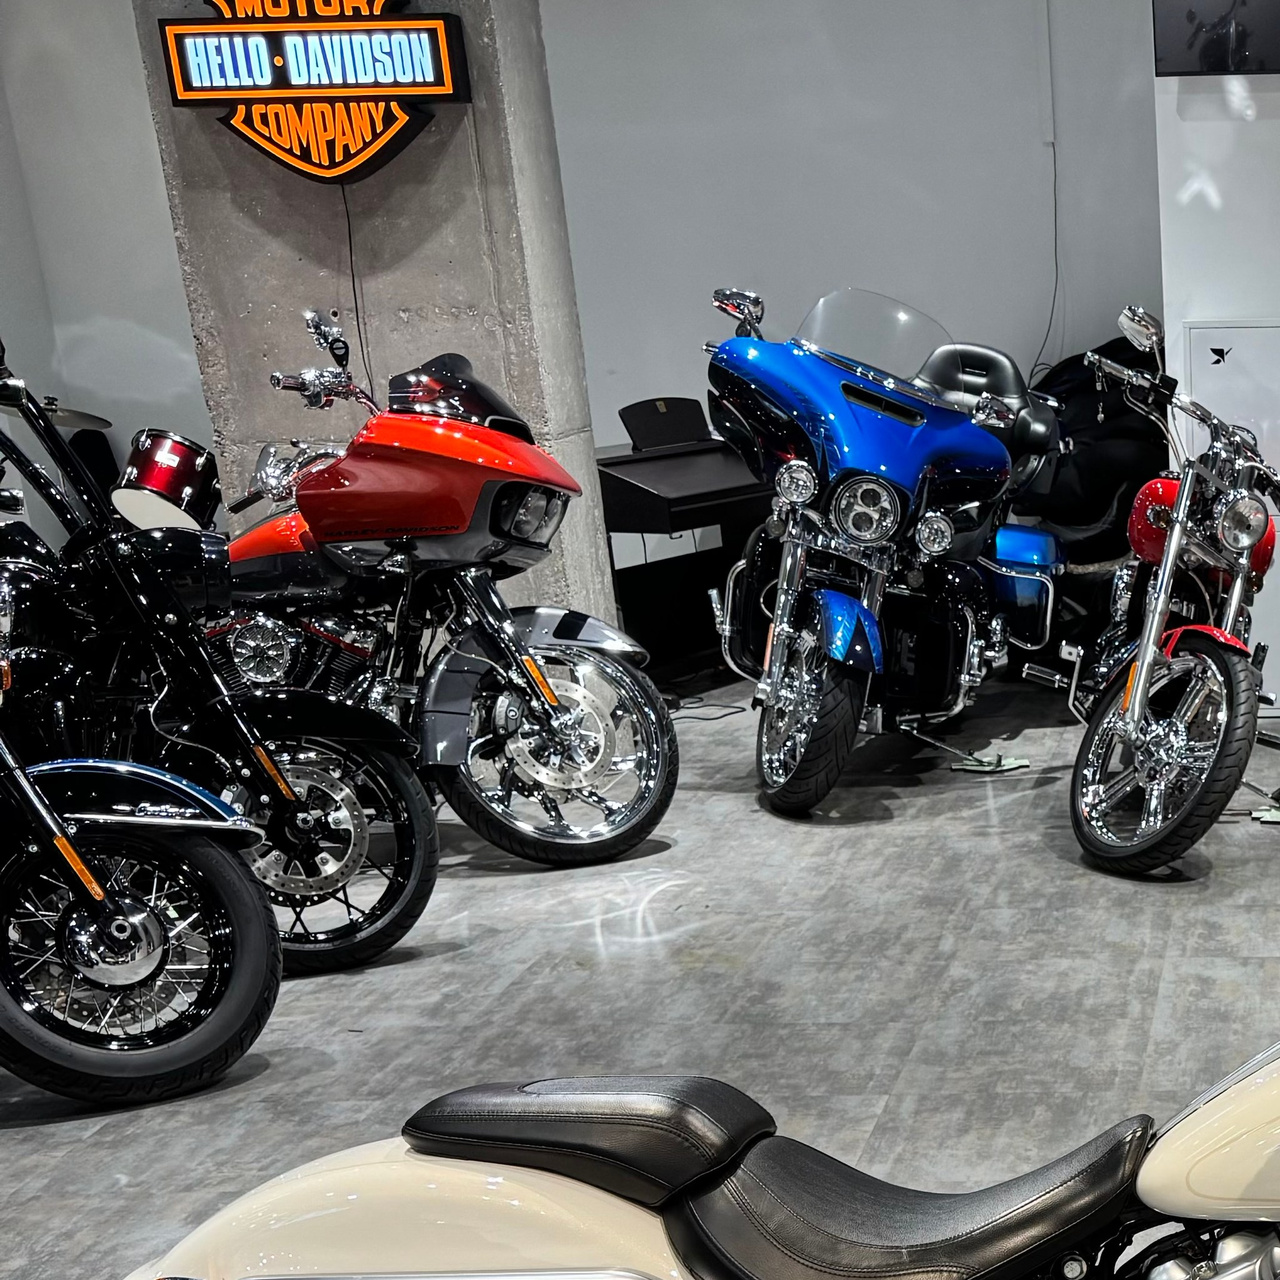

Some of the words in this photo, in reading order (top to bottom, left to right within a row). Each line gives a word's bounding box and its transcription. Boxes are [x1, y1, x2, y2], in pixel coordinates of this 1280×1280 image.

[184, 36, 272, 87] HELLO
[284, 34, 435, 85] DAVIDSON
[252, 102, 386, 166] COMPANY
